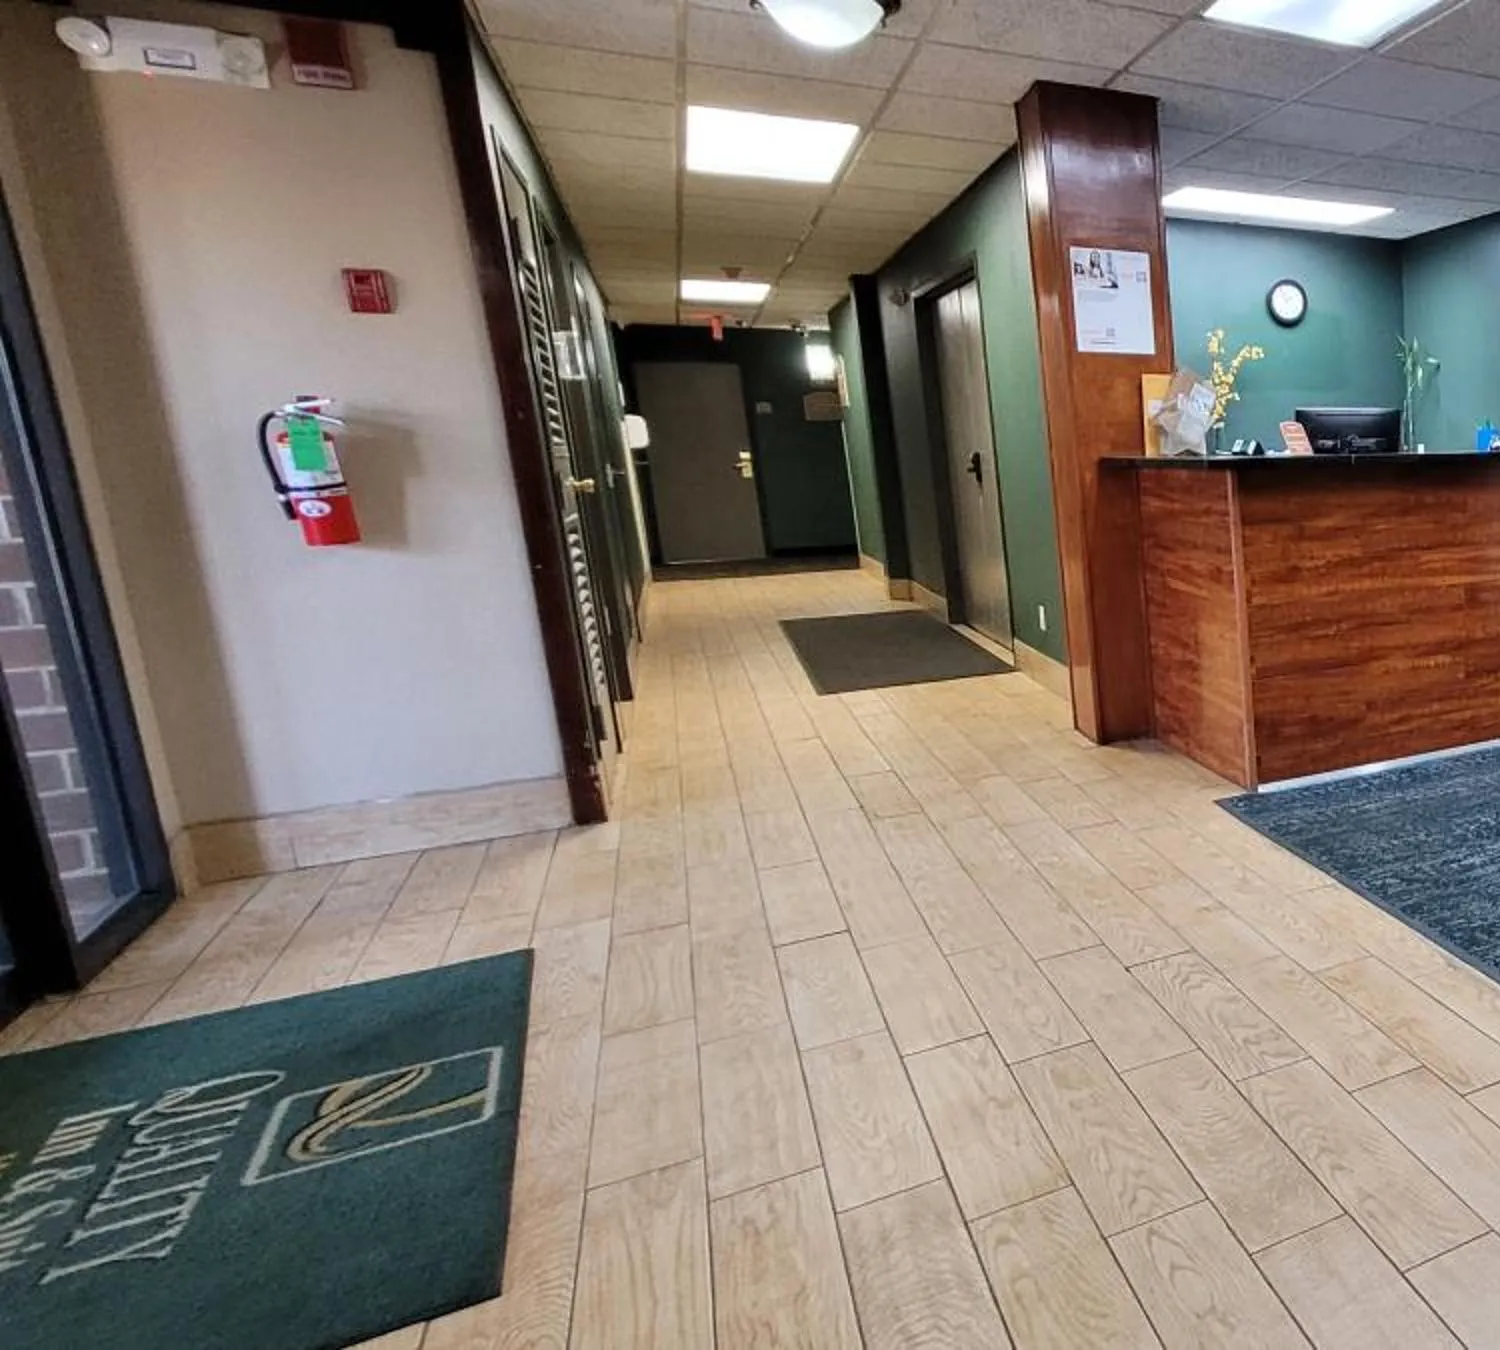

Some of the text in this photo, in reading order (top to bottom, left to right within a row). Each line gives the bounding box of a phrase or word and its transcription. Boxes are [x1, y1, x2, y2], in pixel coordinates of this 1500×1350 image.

[31, 1100, 141, 1165] Inn
[0, 1163, 97, 1204] &
[37, 1069, 287, 1285] QUALITY
